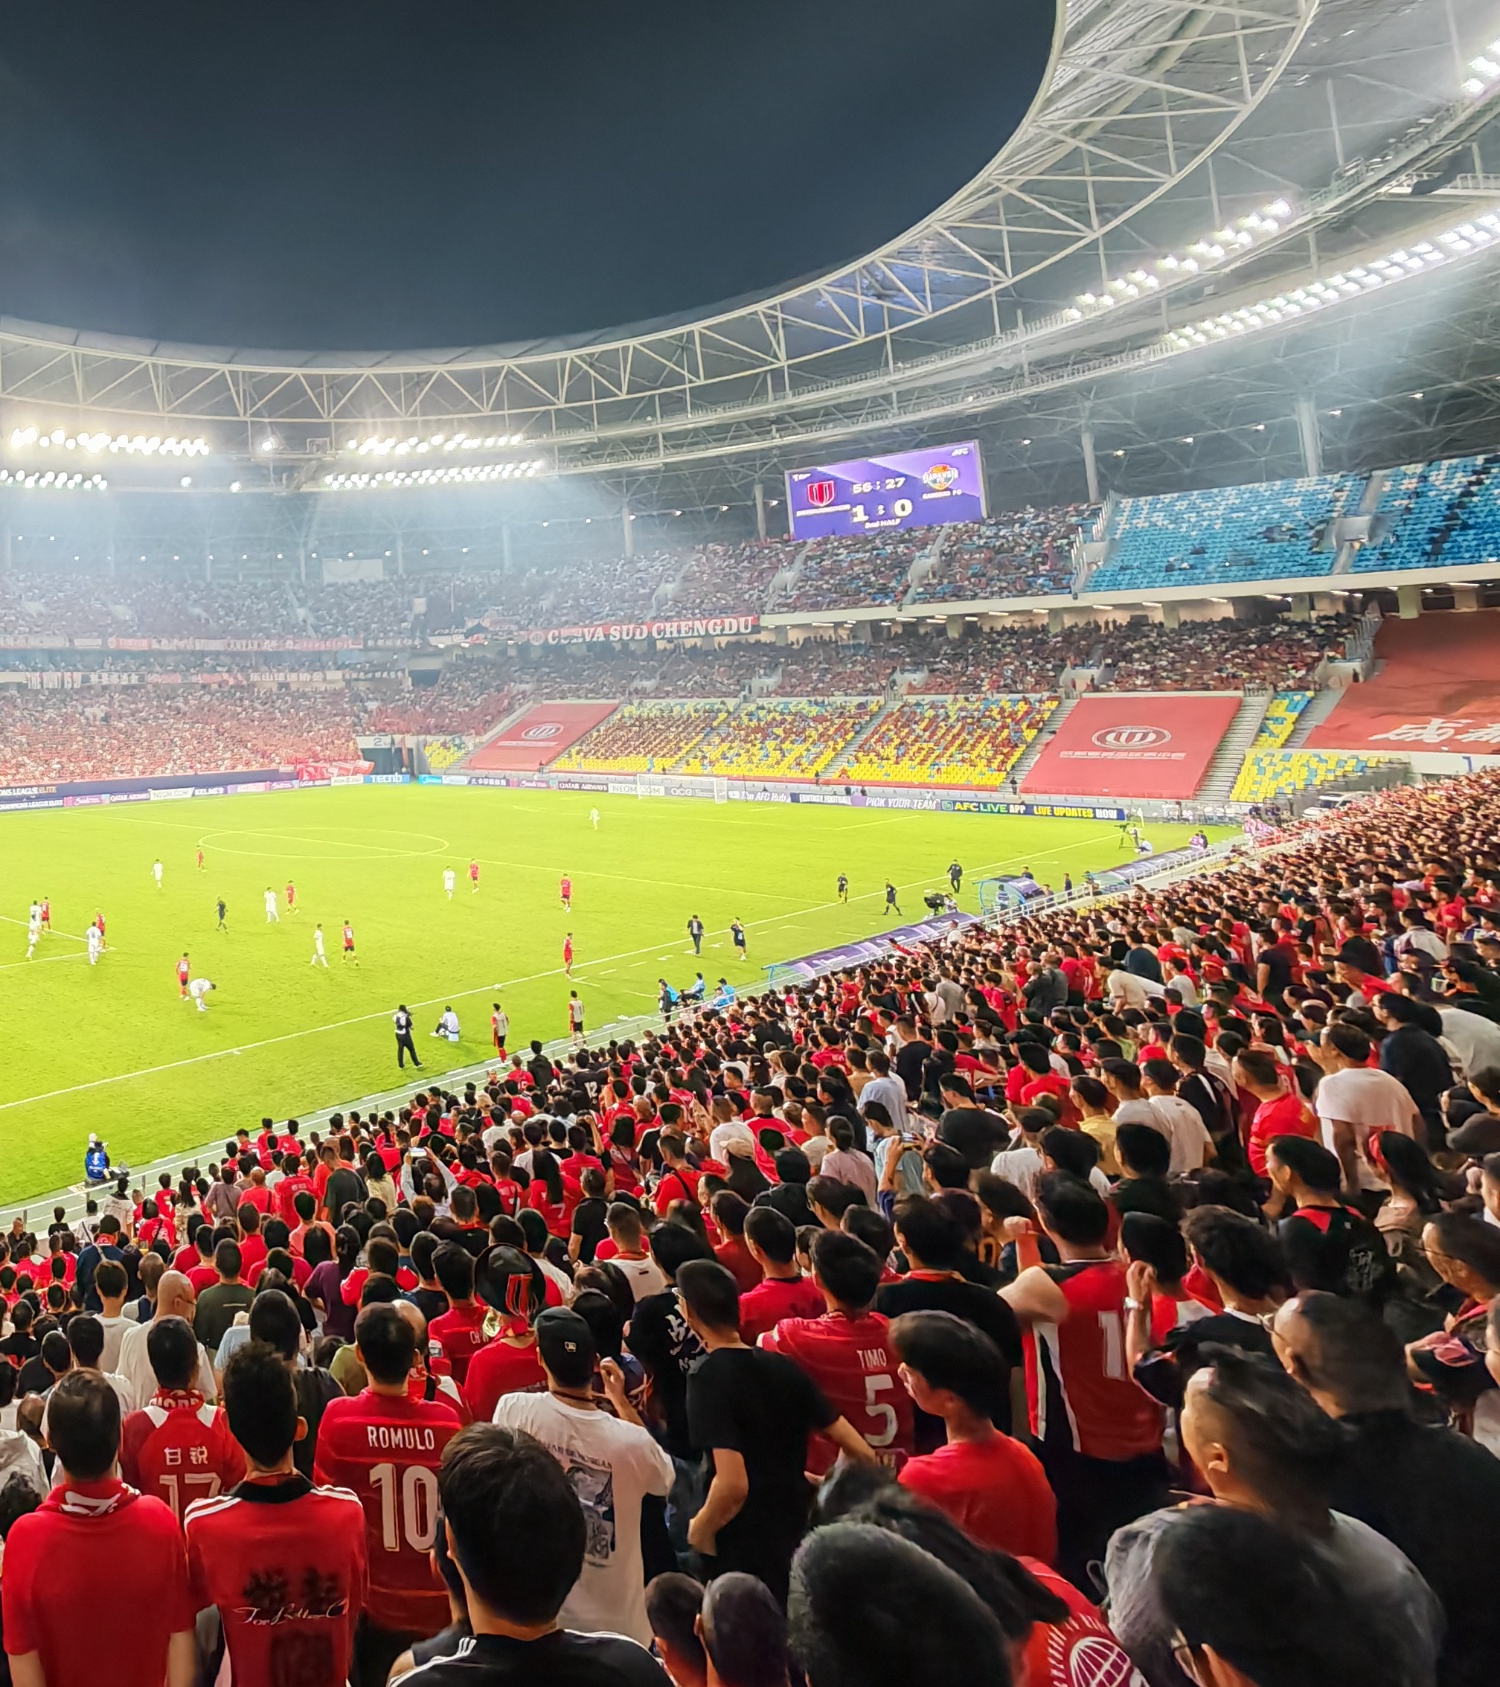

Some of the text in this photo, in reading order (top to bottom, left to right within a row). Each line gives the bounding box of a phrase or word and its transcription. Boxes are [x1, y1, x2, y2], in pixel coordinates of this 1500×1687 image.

[852, 482, 872, 494] 56
[885, 477, 906, 490] 27
[852, 504, 869, 523] 1
[893, 498, 913, 518] 0
[609, 623, 649, 641] SUD
[652, 615, 754, 640] CHENGDU
[865, 797, 938, 810] PICK YOUR TEAM
[954, 801, 1026, 814] AFC LIVE APP
[1033, 805, 1117, 819] LIVE UPDATES NOW
[856, 1347, 887, 1370] TIMO
[863, 1373, 899, 1447] 5
[366, 1425, 436, 1451] ROMULO
[369, 1462, 439, 1554] 10
